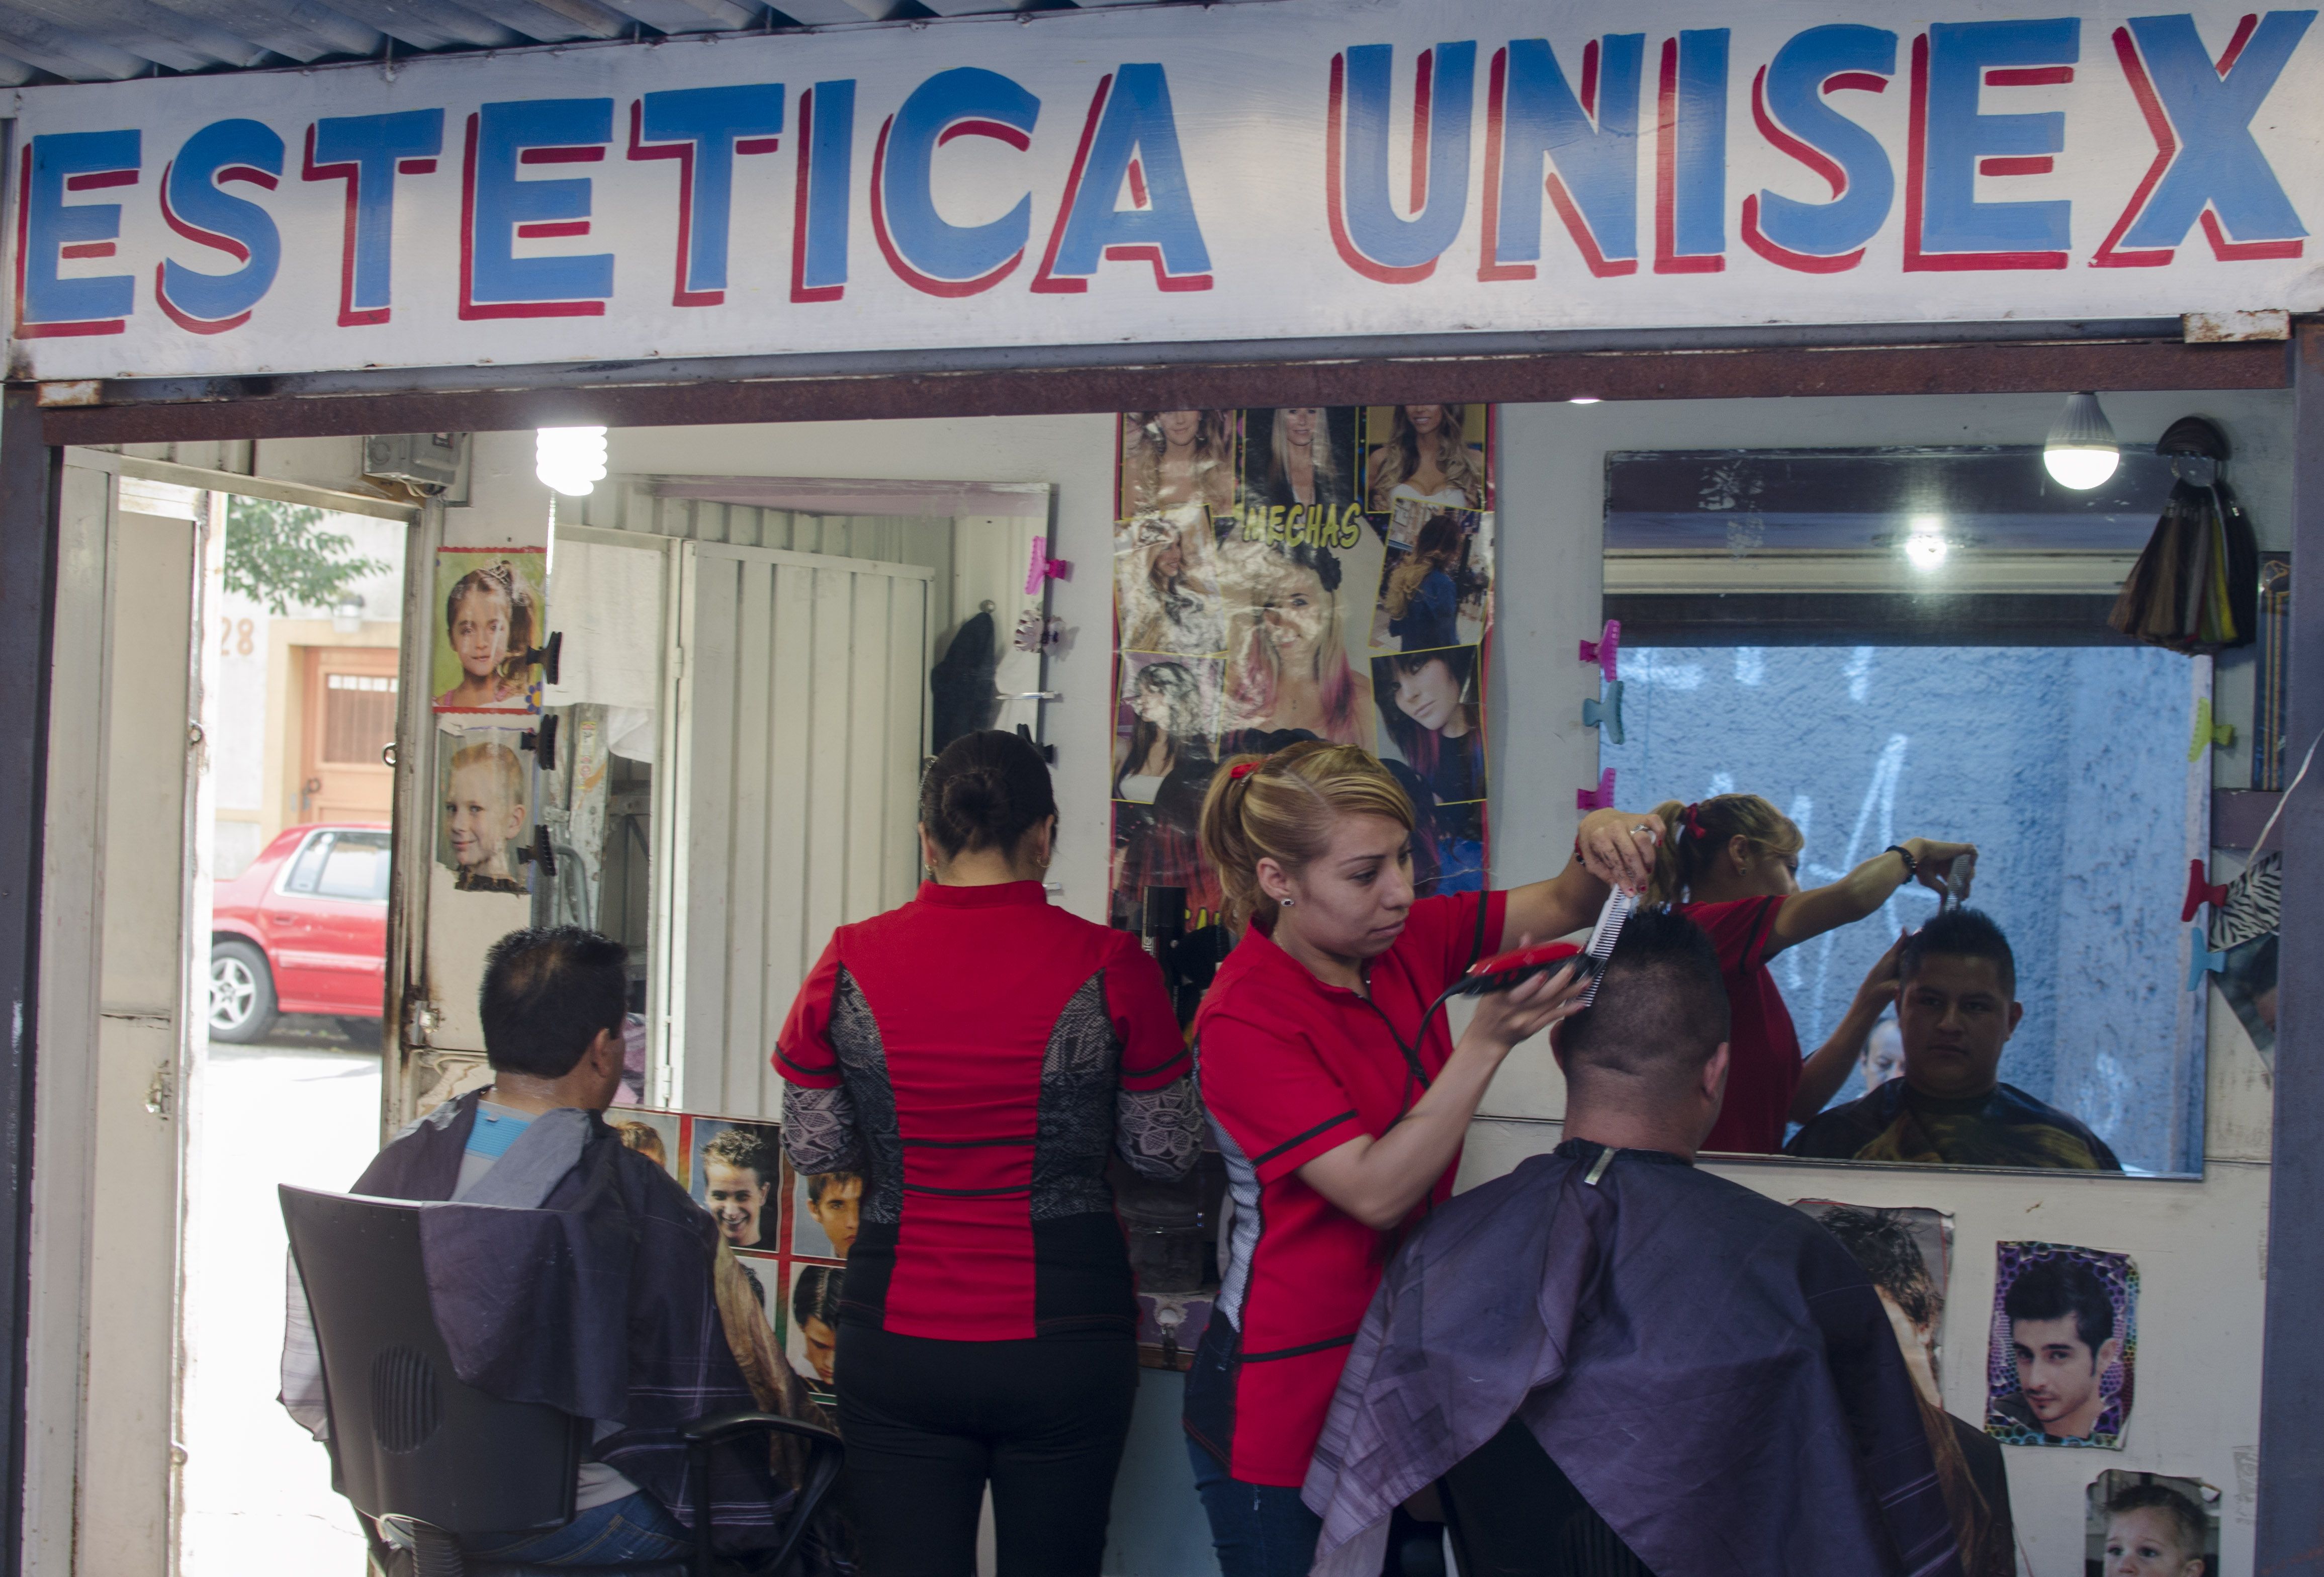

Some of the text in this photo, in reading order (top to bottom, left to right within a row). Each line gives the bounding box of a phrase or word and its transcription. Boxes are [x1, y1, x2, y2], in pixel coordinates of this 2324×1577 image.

[16, 10, 2318, 339] ESTETICA UNISEX
[1242, 502, 1361, 549] MECHAS
